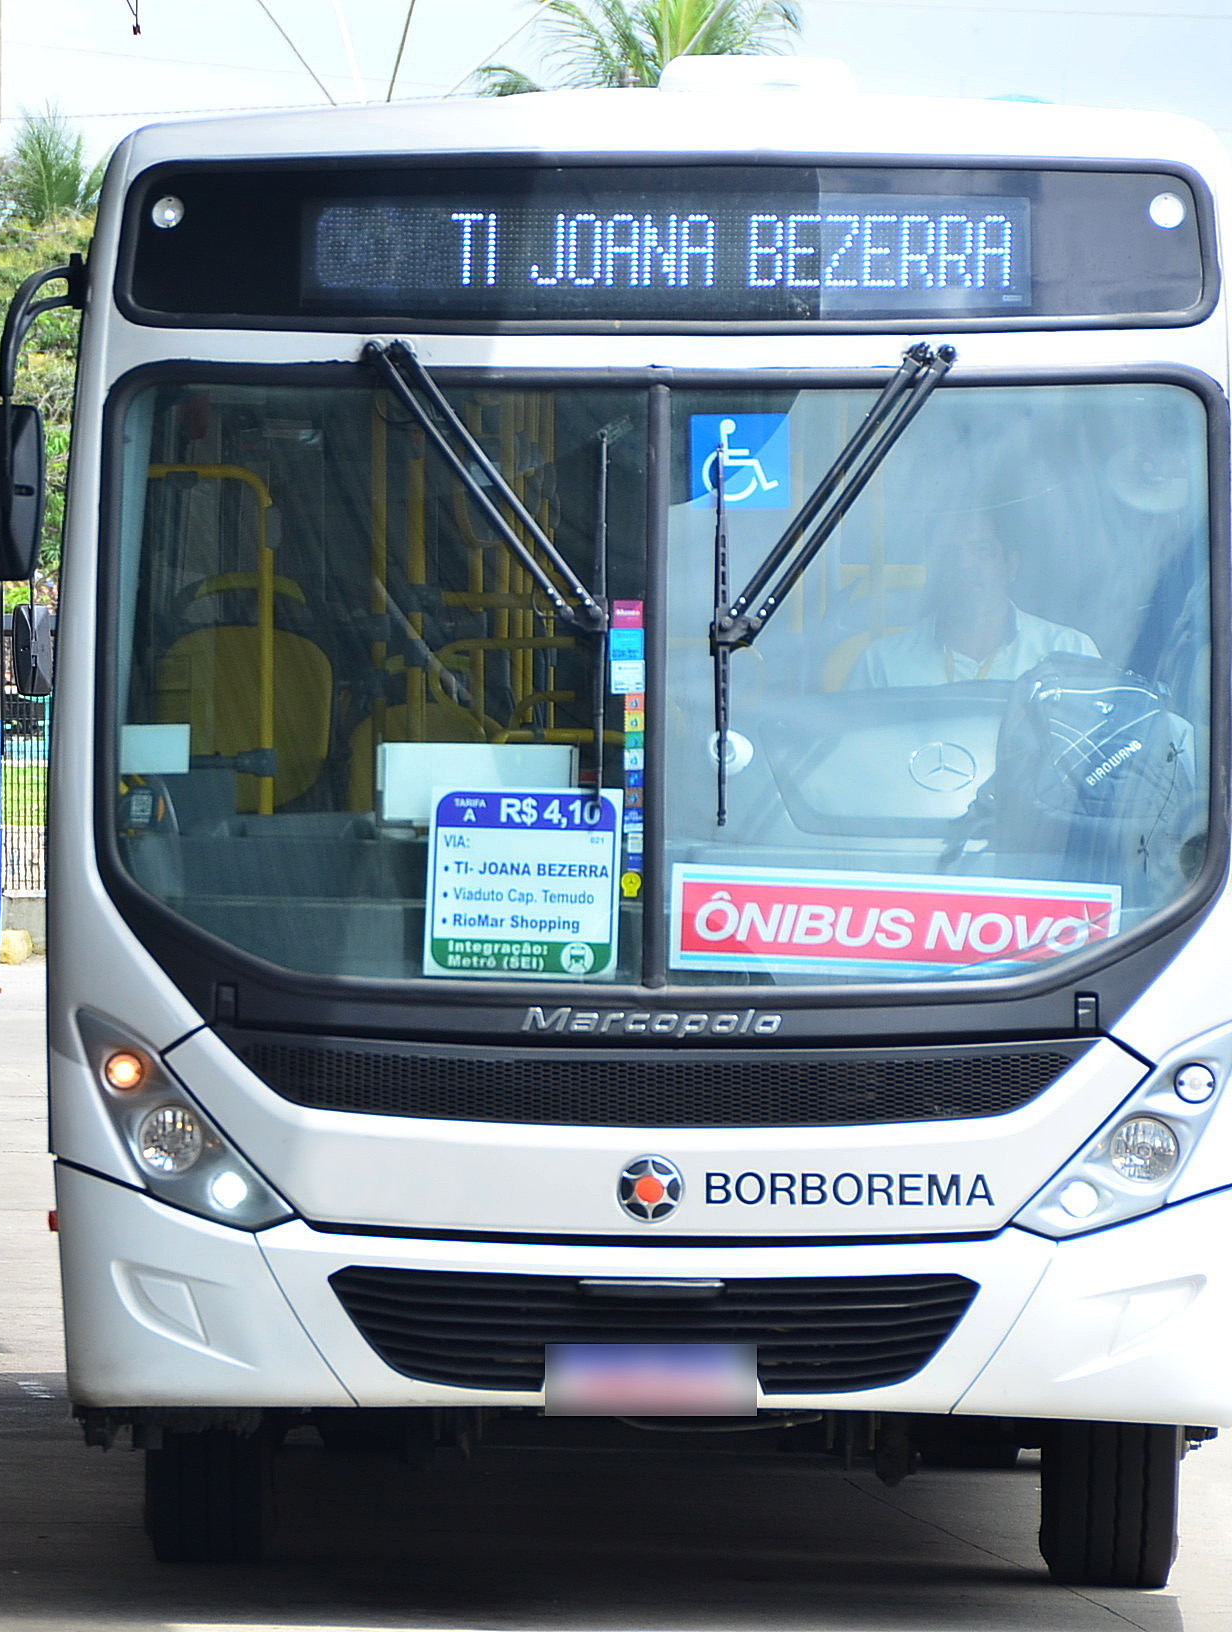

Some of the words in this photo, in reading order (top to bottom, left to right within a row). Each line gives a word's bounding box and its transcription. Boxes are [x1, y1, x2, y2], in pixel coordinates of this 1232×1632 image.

[451, 212, 496, 286] TI
[531, 213, 715, 286] JOANA
[749, 214, 1012, 288] BEZERRA
[454, 798, 487, 808] TARIFA
[499, 797, 538, 826] R$
[463, 808, 476, 822] A
[443, 834, 470, 848] VIA:
[478, 862, 531, 876] JOANA
[537, 863, 609, 879] BEZERRA
[453, 887, 504, 902] Viaduto
[508, 888, 537, 906] Cap.
[542, 889, 595, 905] Temudo
[453, 913, 506, 928] RioMar
[510, 915, 580, 933] Shopping
[695, 890, 915, 949] ÔNIBUS
[924, 911, 1088, 954] NOVO
[447, 939, 548, 957] Integração:
[447, 954, 496, 969] Metrô
[503, 955, 544, 971] (SEI)
[521, 1006, 783, 1038] Marcopolo
[705, 1171, 995, 1207] BORBOREMA
